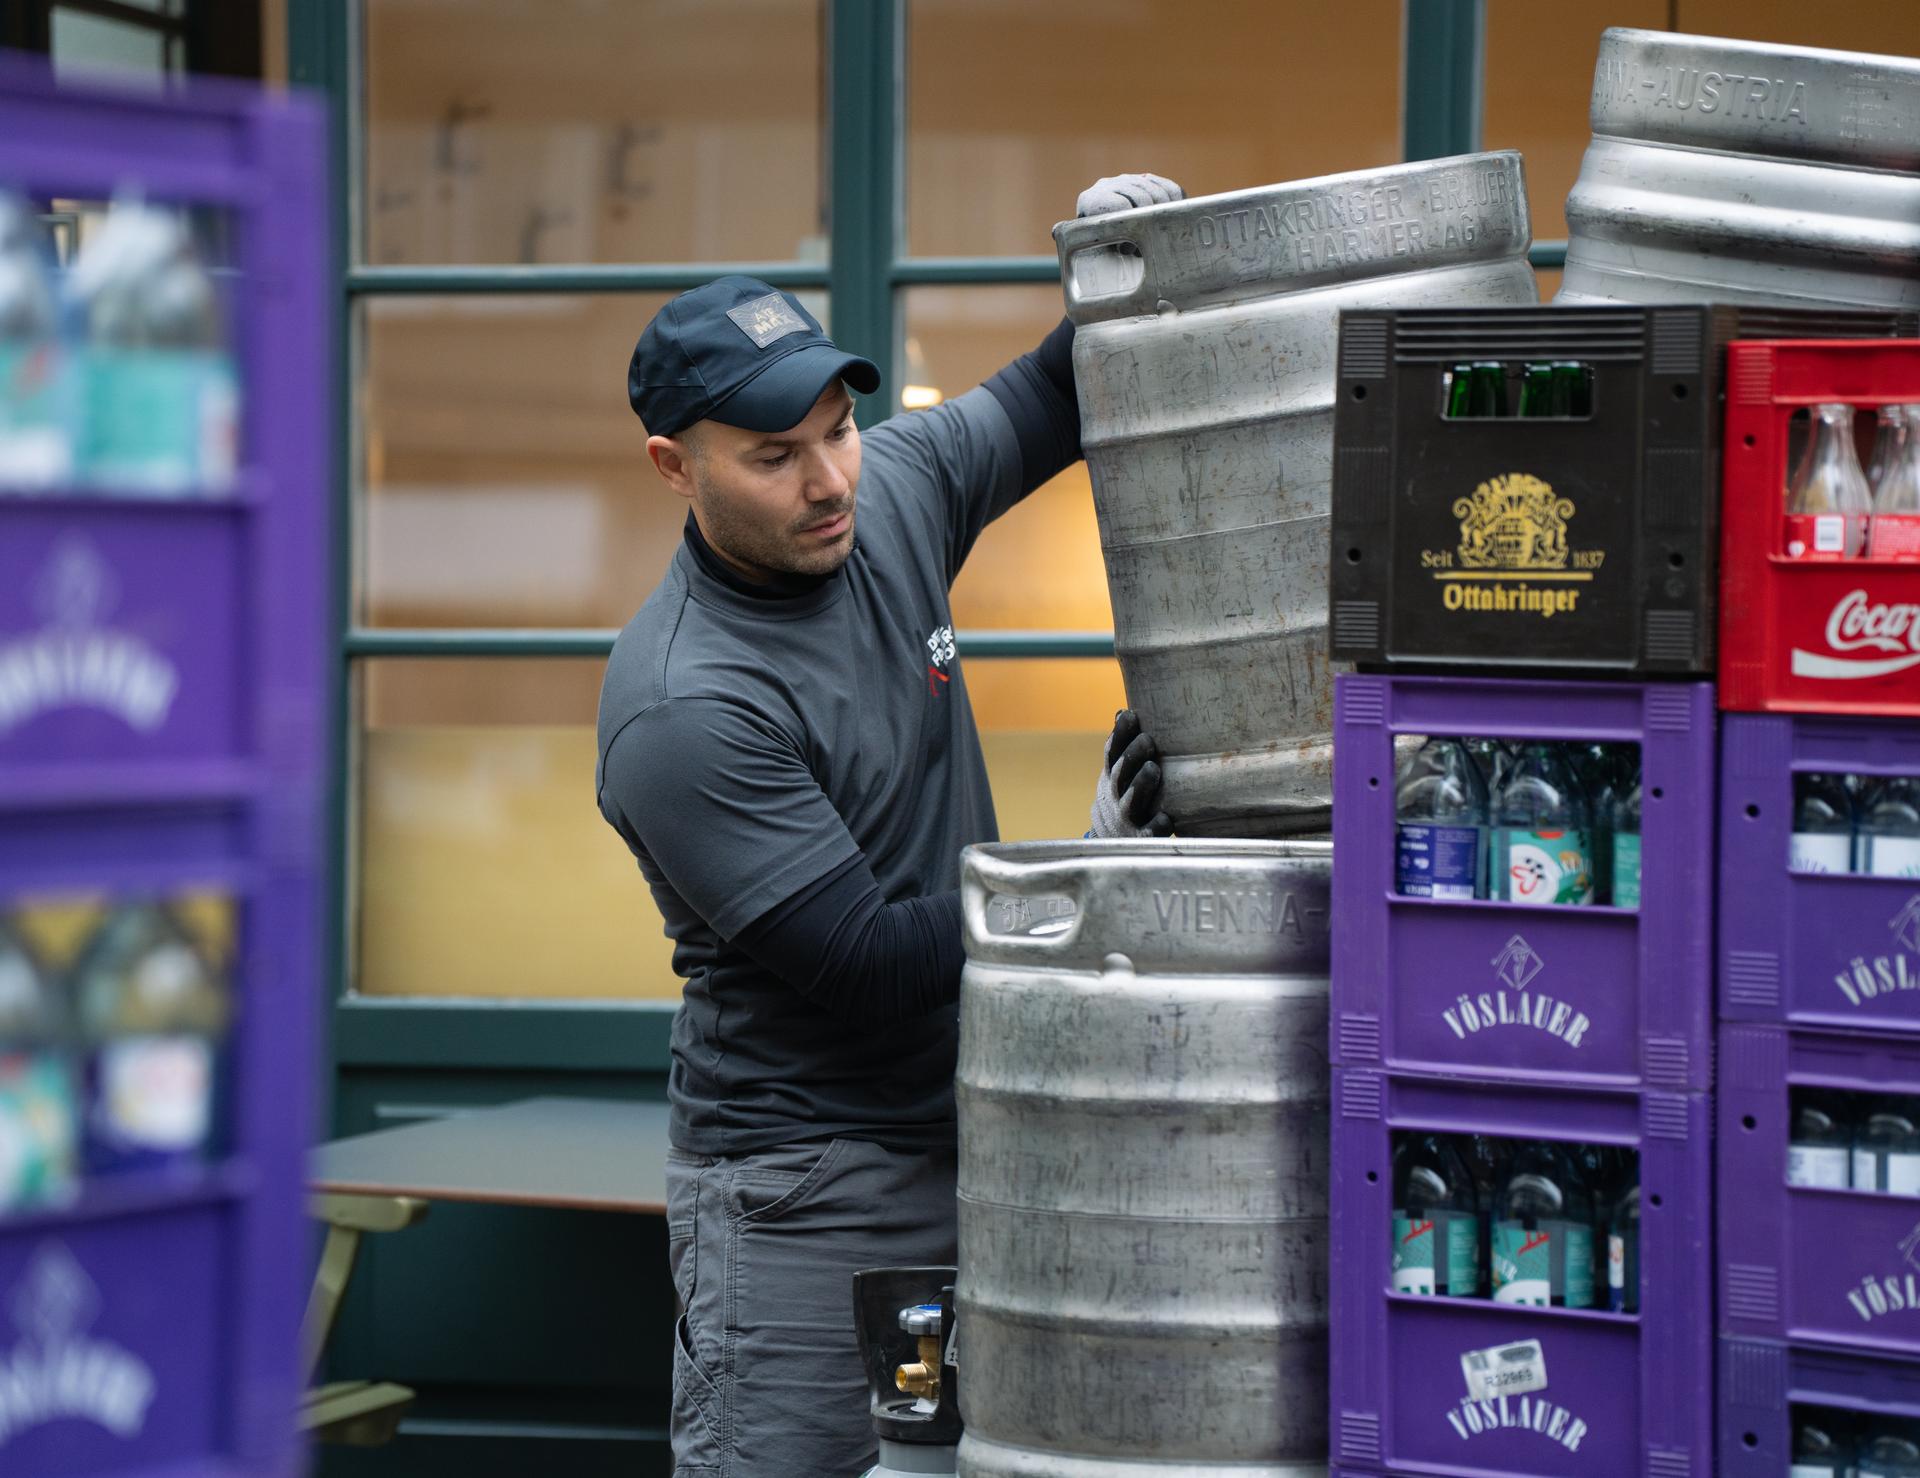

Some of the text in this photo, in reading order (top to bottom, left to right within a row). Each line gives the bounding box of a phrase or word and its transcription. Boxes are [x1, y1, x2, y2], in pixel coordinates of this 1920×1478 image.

[1199, 186, 1404, 249] OTTAKRINGER
[1295, 221, 1426, 270] HARMER
[1421, 549, 1605, 569] Seit 1837
[1443, 582, 1580, 618] Ottakringer
[1152, 889, 1331, 936] VIENNA-
[1834, 953, 1920, 1006] VÖSL
[1442, 990, 1591, 1049] VÖSLAUER
[1847, 1274, 1920, 1322] VÖSL
[1446, 1394, 1589, 1453] VÖSLAUER
